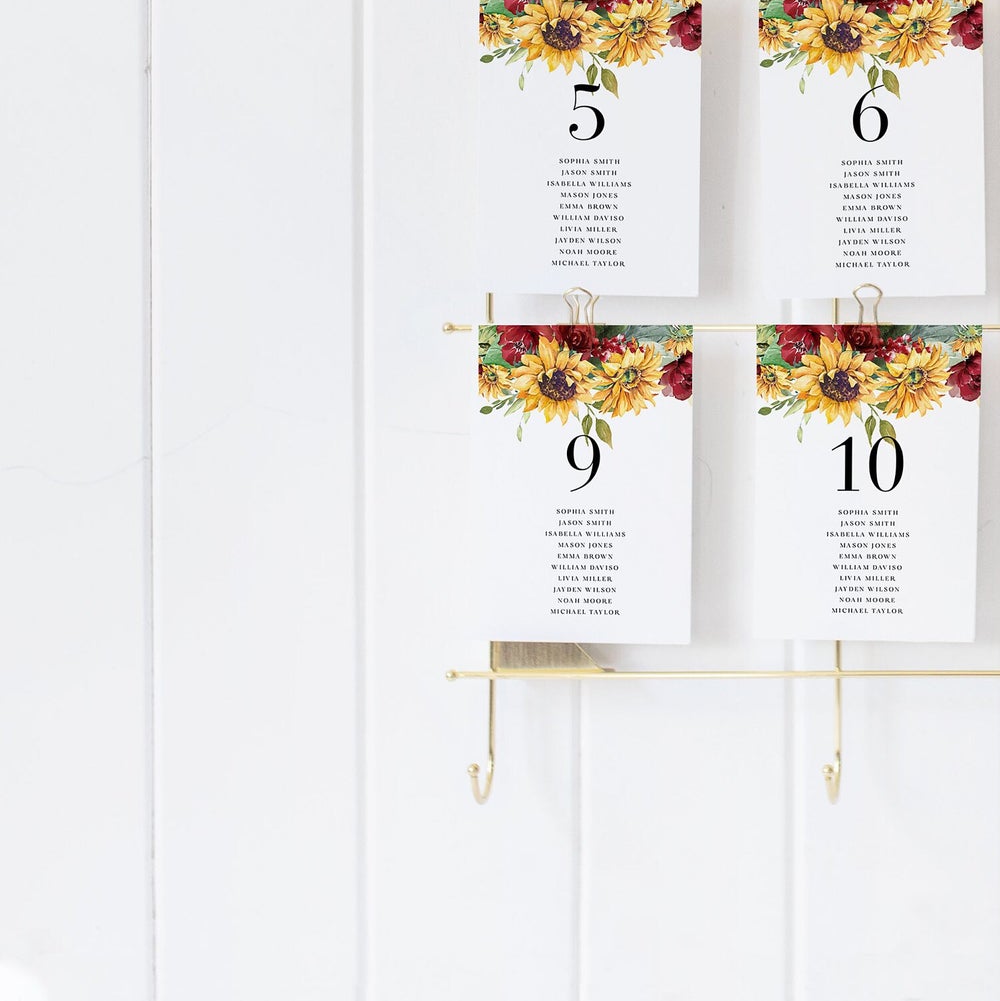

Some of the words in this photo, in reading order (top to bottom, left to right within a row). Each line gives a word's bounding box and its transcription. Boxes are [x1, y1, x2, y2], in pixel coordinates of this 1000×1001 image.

[568, 83, 605, 141] 5
[852, 84, 889, 143] 6
[840, 159, 873, 167] SOPHIA
[561, 169, 588, 177] JASON
[871, 181, 916, 189] WILLIAMS
[560, 191, 590, 199] MASON
[592, 192, 619, 200] JONES
[842, 204, 868, 212] EMMA
[870, 204, 902, 212] BROWN
[552, 214, 591, 222] WILLIAM
[593, 214, 625, 223] DAVISO
[869, 226, 902, 234] MILLER
[554, 237, 586, 245] JAYDEN
[588, 237, 622, 245] WILSON
[870, 249, 902, 257] MOORE
[551, 259, 590, 267] MICHAEL
[591, 260, 626, 268] TAYLOR
[834, 261, 874, 269] MICHAEL
[566, 434, 601, 492] 9
[831, 435, 904, 492] 10
[588, 508, 615, 516] SMITH
[840, 520, 866, 528] JASON
[544, 530, 583, 538] ISABELLA
[585, 530, 626, 538] WILLIAMS
[870, 542, 897, 550] JONES
[557, 552, 581, 560] EMMA
[832, 563, 870, 571] WILLIAM
[582, 575, 613, 583] MILLER
[834, 585, 865, 593] JAYDEN
[866, 585, 900, 593] WILSON
[583, 597, 613, 605] MOORE
[871, 607, 904, 615] TAYLOR
